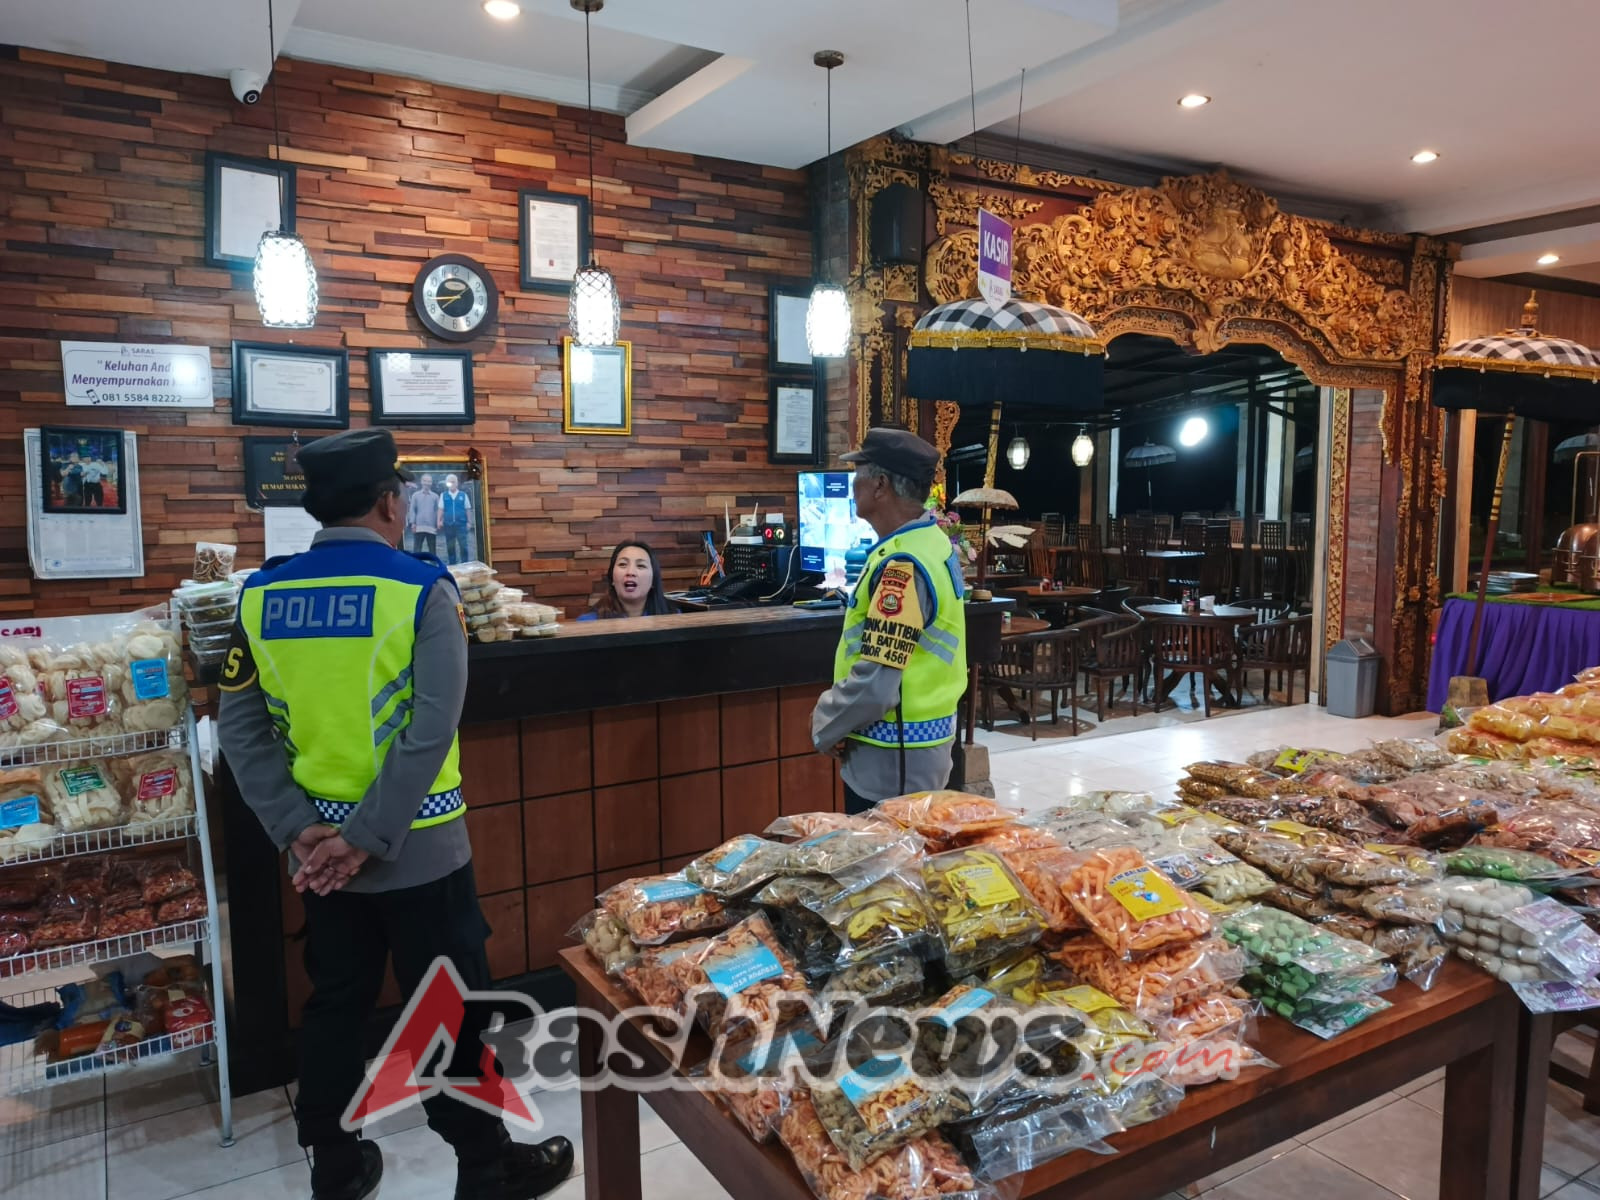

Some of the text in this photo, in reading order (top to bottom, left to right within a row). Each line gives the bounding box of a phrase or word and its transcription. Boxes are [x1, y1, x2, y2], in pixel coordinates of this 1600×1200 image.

[983, 230, 1009, 266] KASIR
[104, 360, 176, 374] Keluhan And
[72, 374, 169, 388] Menyempurnakan
[102, 393, 183, 403] 081 5584 82222
[264, 594, 369, 631] POLISI
[884, 651, 908, 666] 4561
